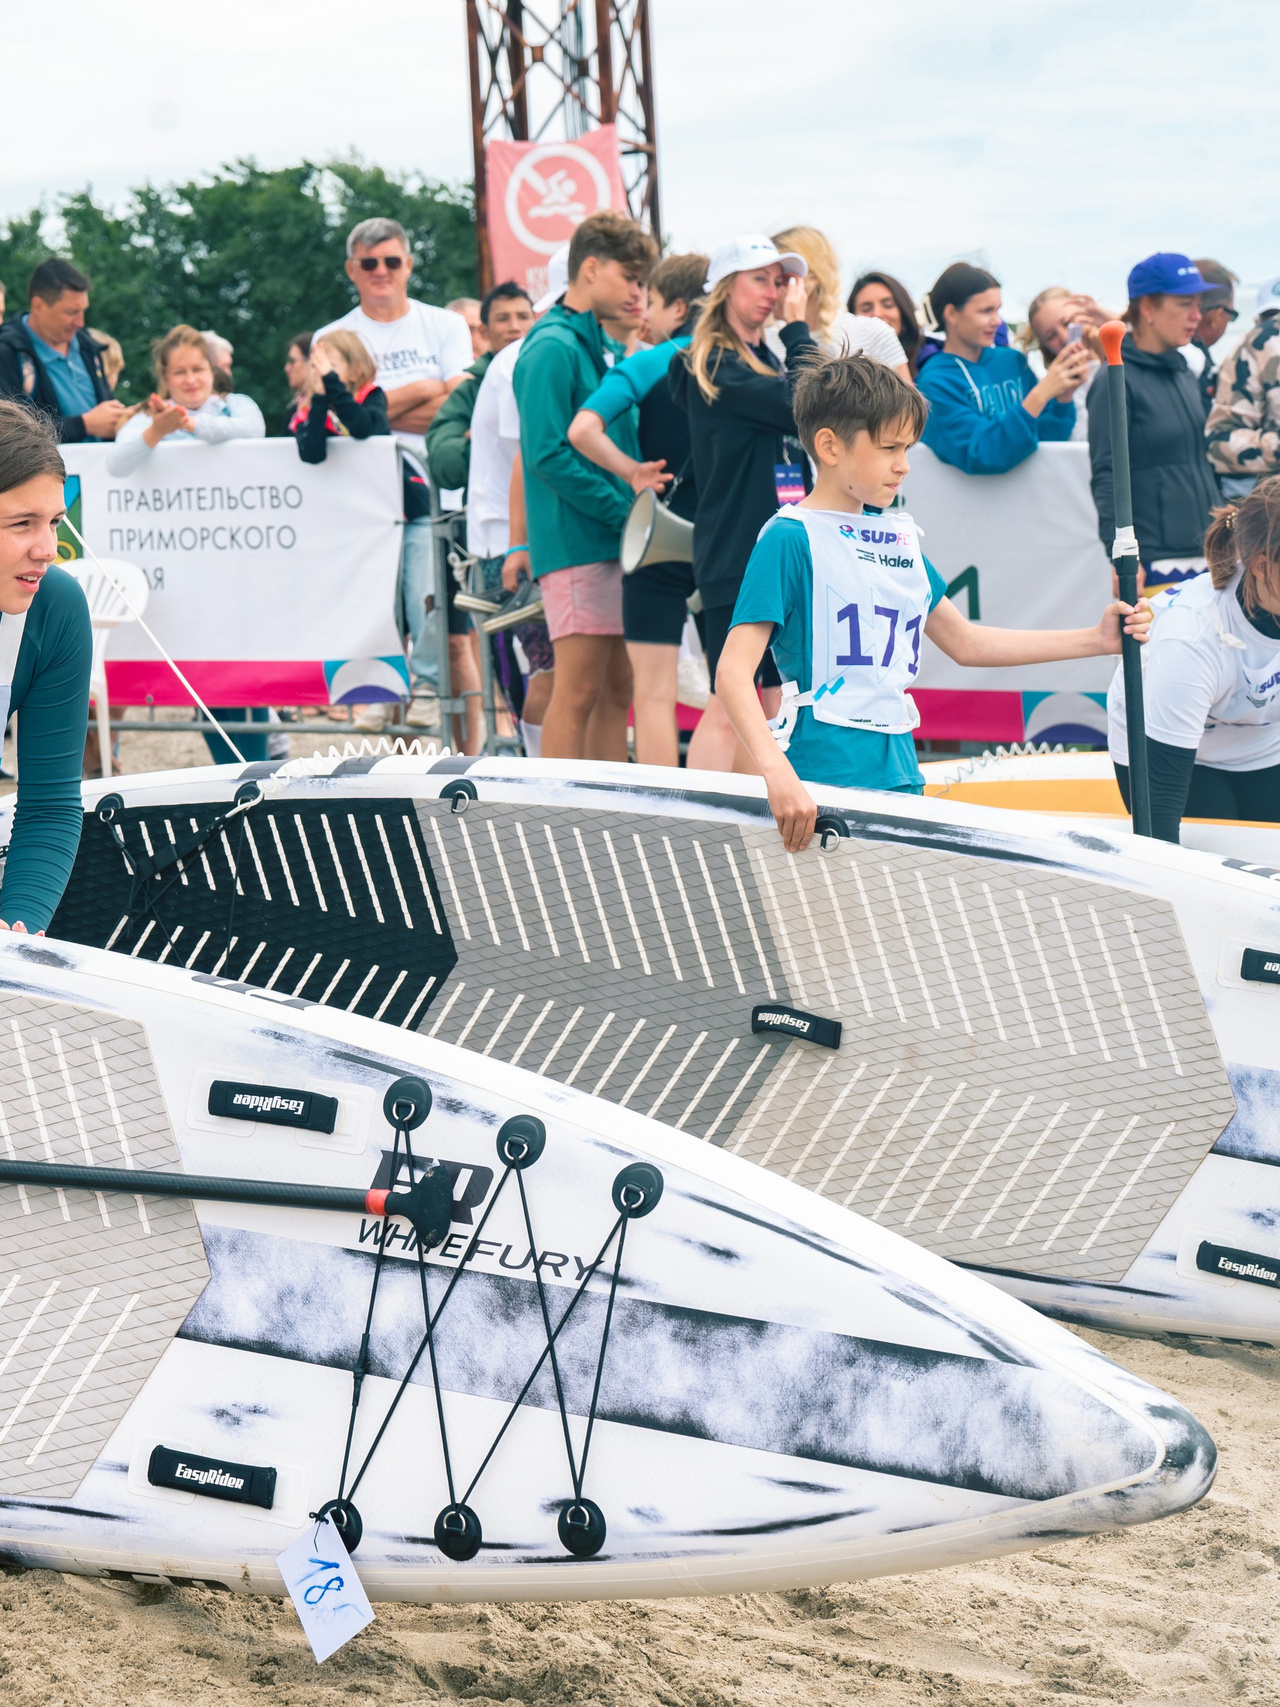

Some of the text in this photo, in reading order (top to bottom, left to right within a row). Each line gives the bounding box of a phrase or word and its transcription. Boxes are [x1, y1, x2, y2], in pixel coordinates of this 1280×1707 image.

[107, 484, 303, 512] ПРАВИТЕЛЬСТВО
[109, 525, 297, 551] ПРИМОРСКОГО
[878, 553, 914, 568] Haier
[836, 602, 922, 676] 171
